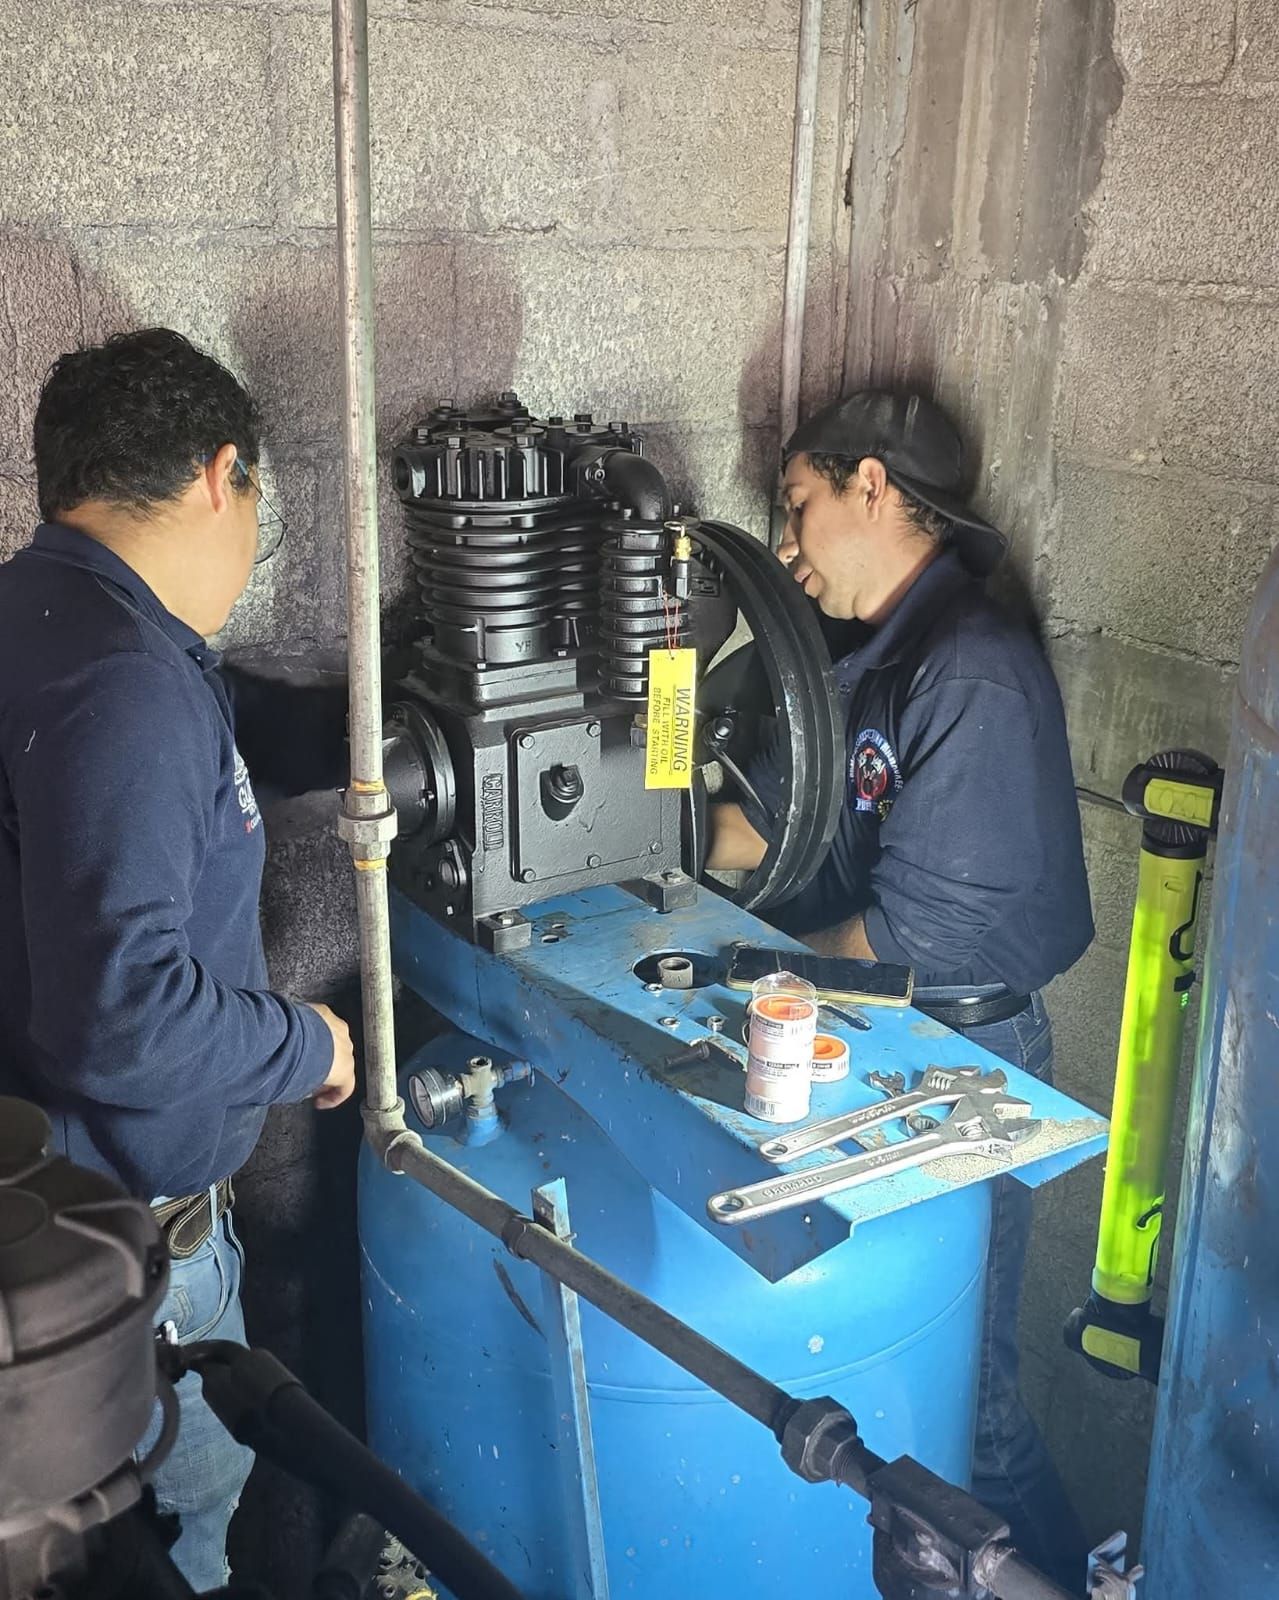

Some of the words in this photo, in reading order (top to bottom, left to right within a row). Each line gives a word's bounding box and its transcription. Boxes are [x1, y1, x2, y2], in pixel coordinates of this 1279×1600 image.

[652, 687, 662, 724] BEFORE
[662, 697, 671, 718] FILL
[661, 720, 670, 747] WITH
[673, 688, 691, 772] WARNING
[650, 728, 660, 775] STARTING
[660, 748, 669, 764] OIL
